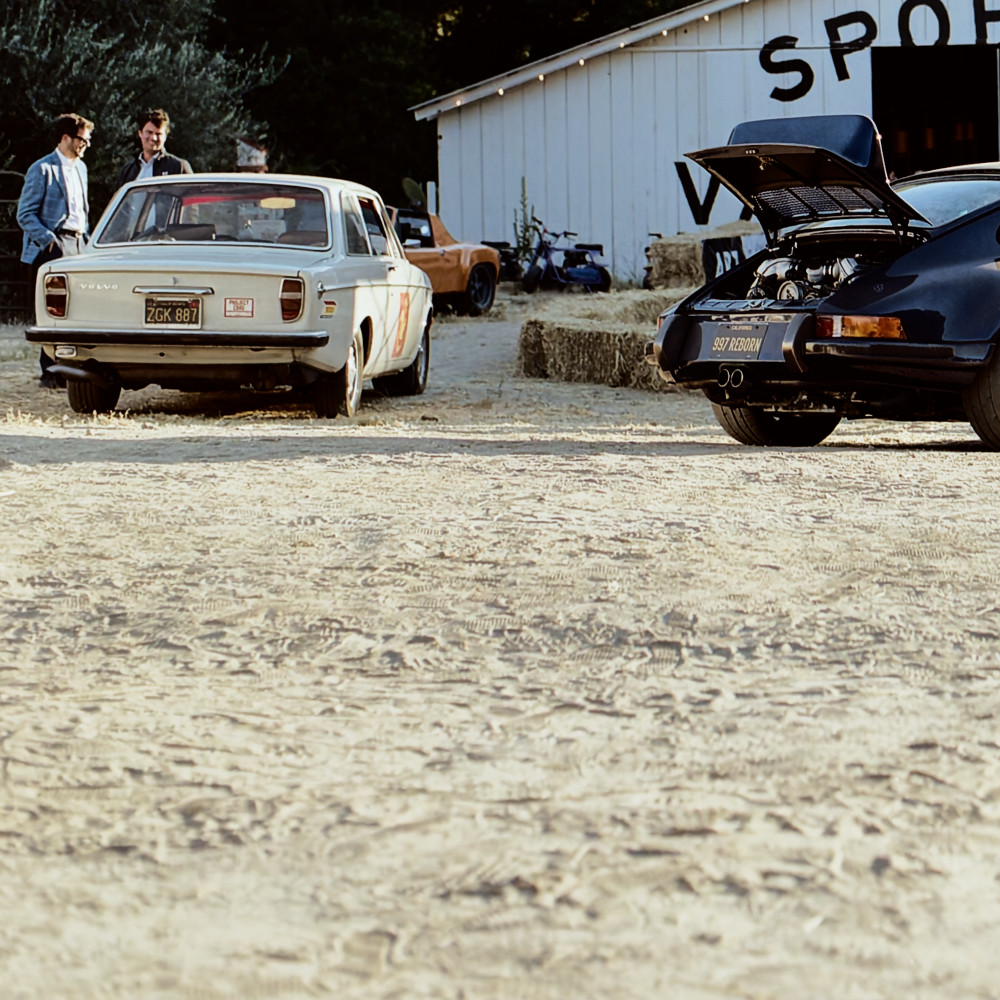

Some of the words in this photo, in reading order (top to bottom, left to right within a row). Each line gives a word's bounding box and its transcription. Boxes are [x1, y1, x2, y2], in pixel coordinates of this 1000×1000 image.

[147, 307, 171, 322] ZGK
[175, 307, 197, 322] 887
[712, 337, 730, 351] 997
[728, 337, 762, 352] REBORN
